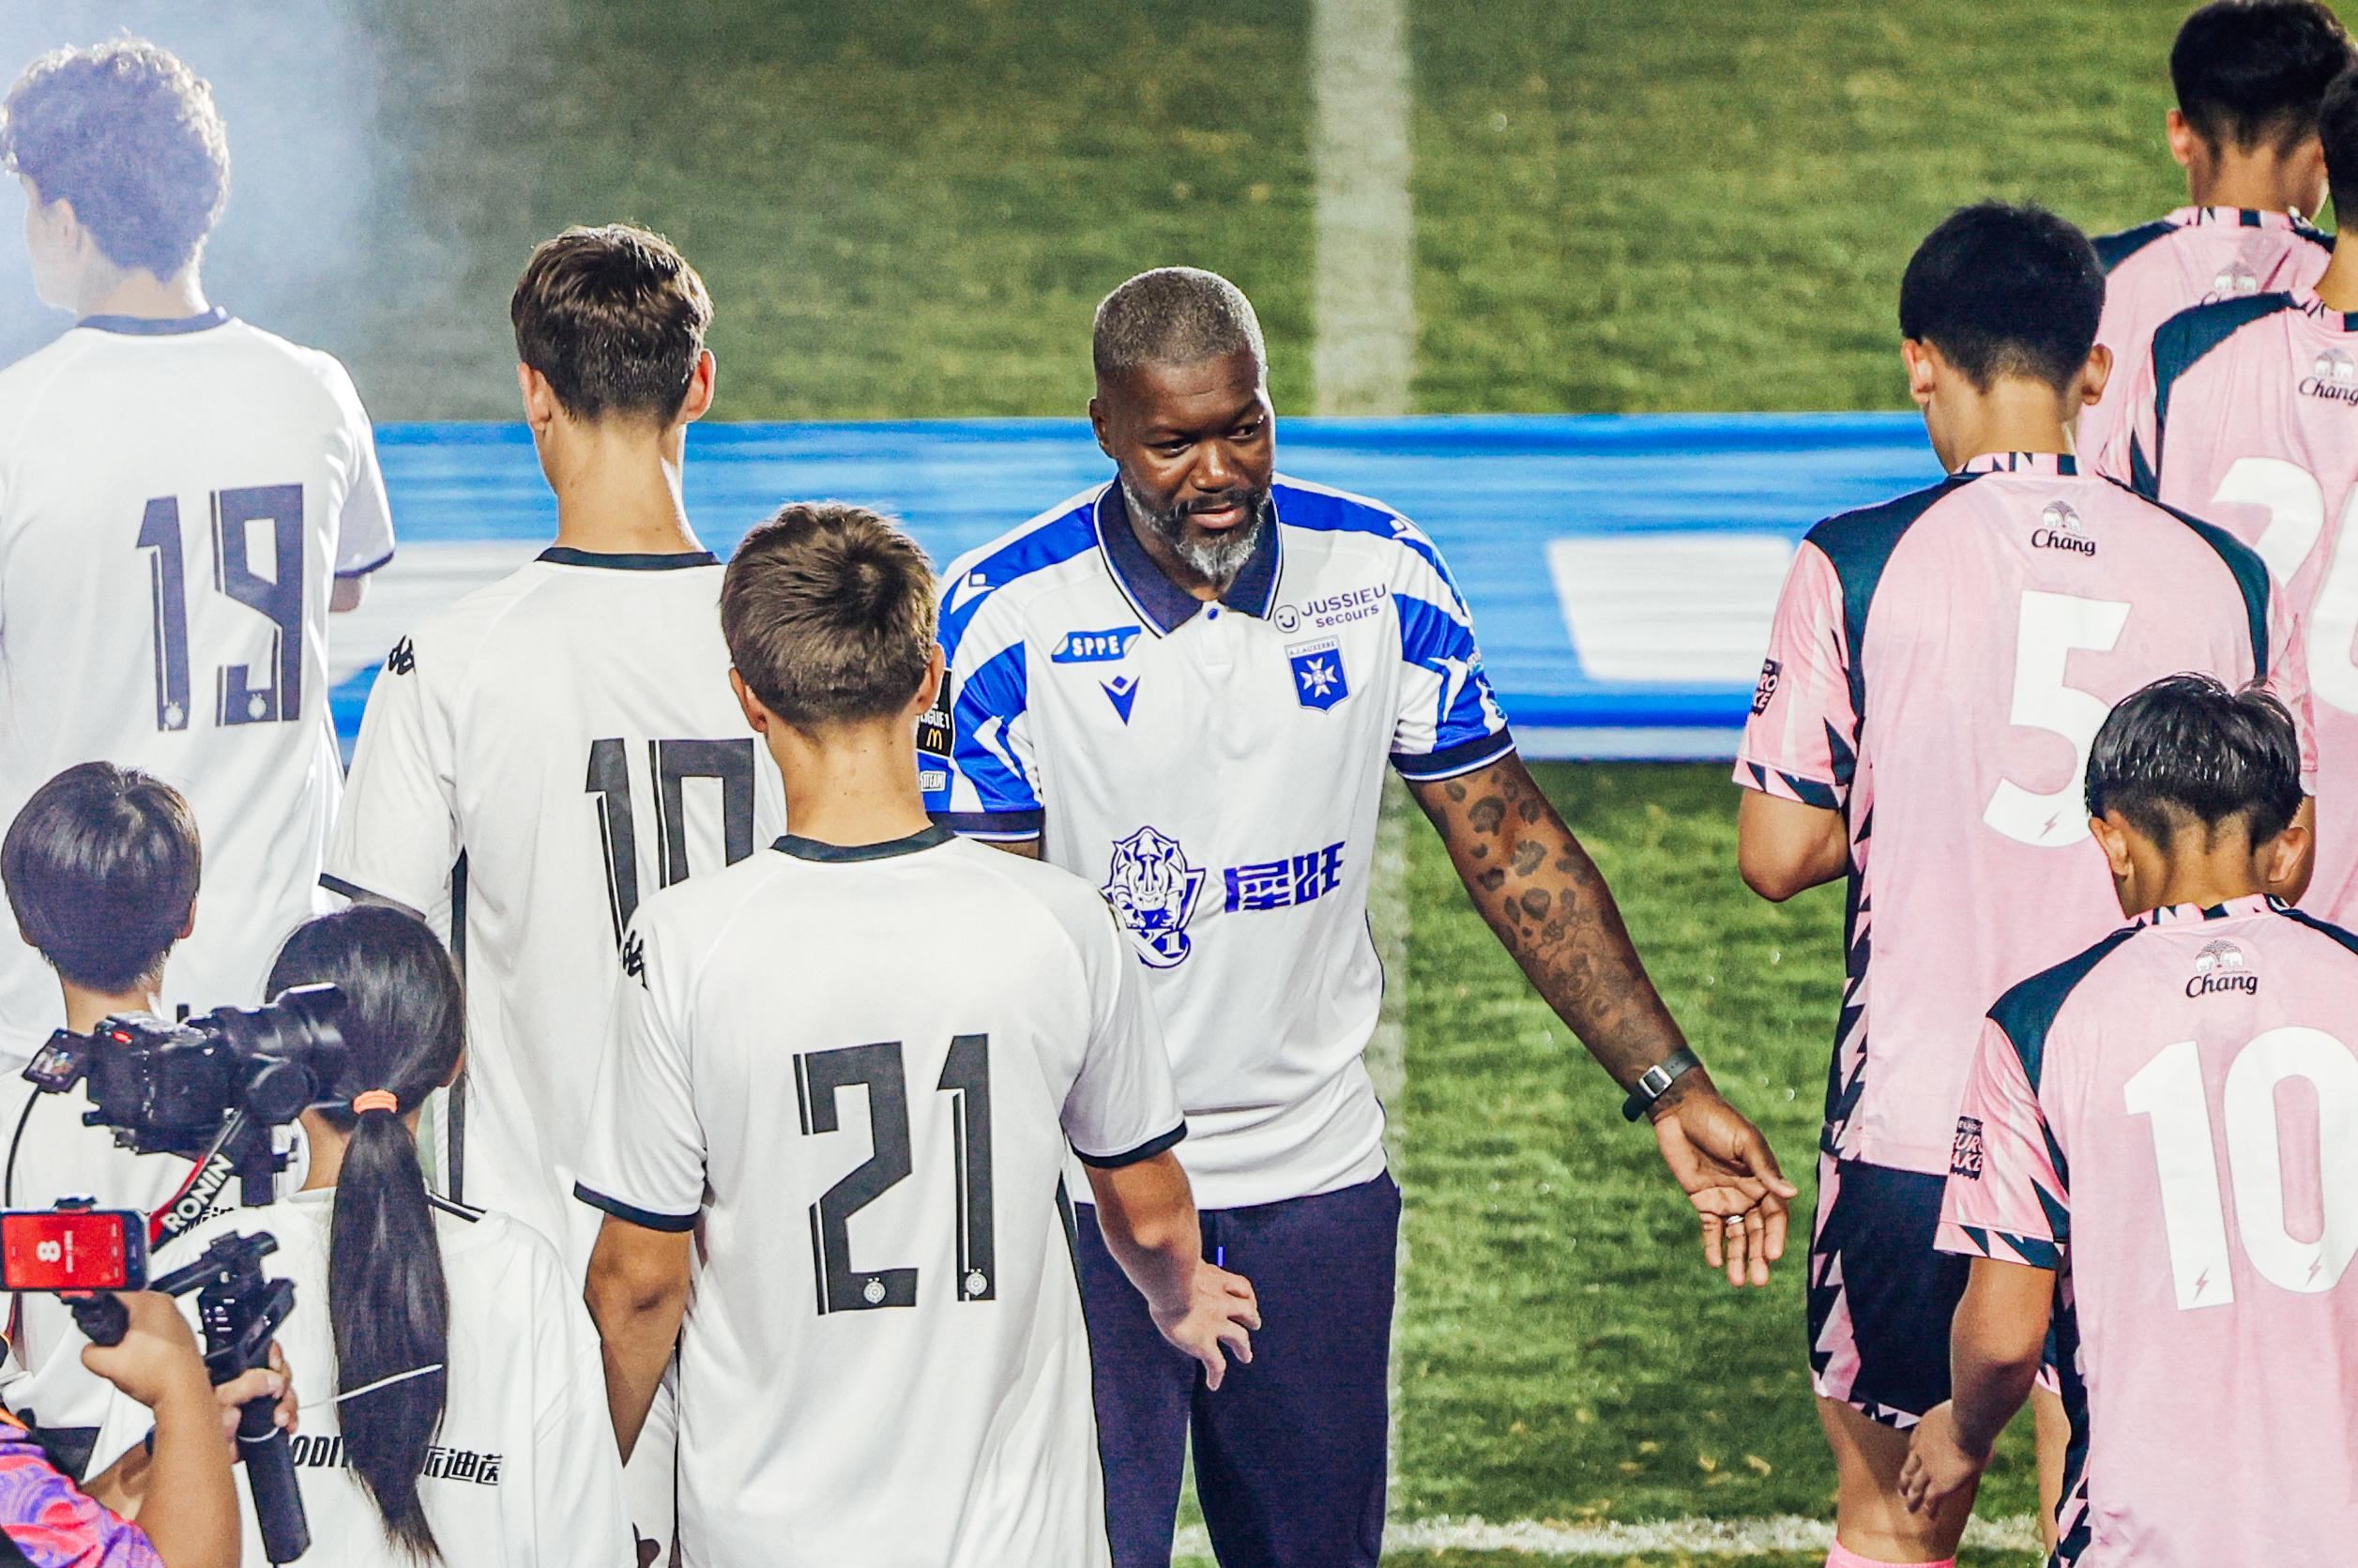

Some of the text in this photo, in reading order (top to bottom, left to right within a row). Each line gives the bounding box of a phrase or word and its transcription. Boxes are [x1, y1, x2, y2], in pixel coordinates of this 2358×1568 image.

[2299, 376, 2358, 406] Chang
[2031, 528, 2096, 556] Chang
[136, 482, 304, 732] 19
[1301, 583, 1387, 617] JUSSIEU
[1316, 604, 1379, 628] secours
[1072, 634, 1120, 657] SPPE
[1982, 589, 2133, 847] 5
[586, 737, 754, 955] 10
[2185, 972, 2259, 998] Chang
[792, 1033, 996, 1315] 21
[2122, 1026, 2358, 1311] 10
[161, 1152, 234, 1233] RONIN
[36, 1240, 62, 1263] 8
[292, 1434, 349, 1468] ODI
